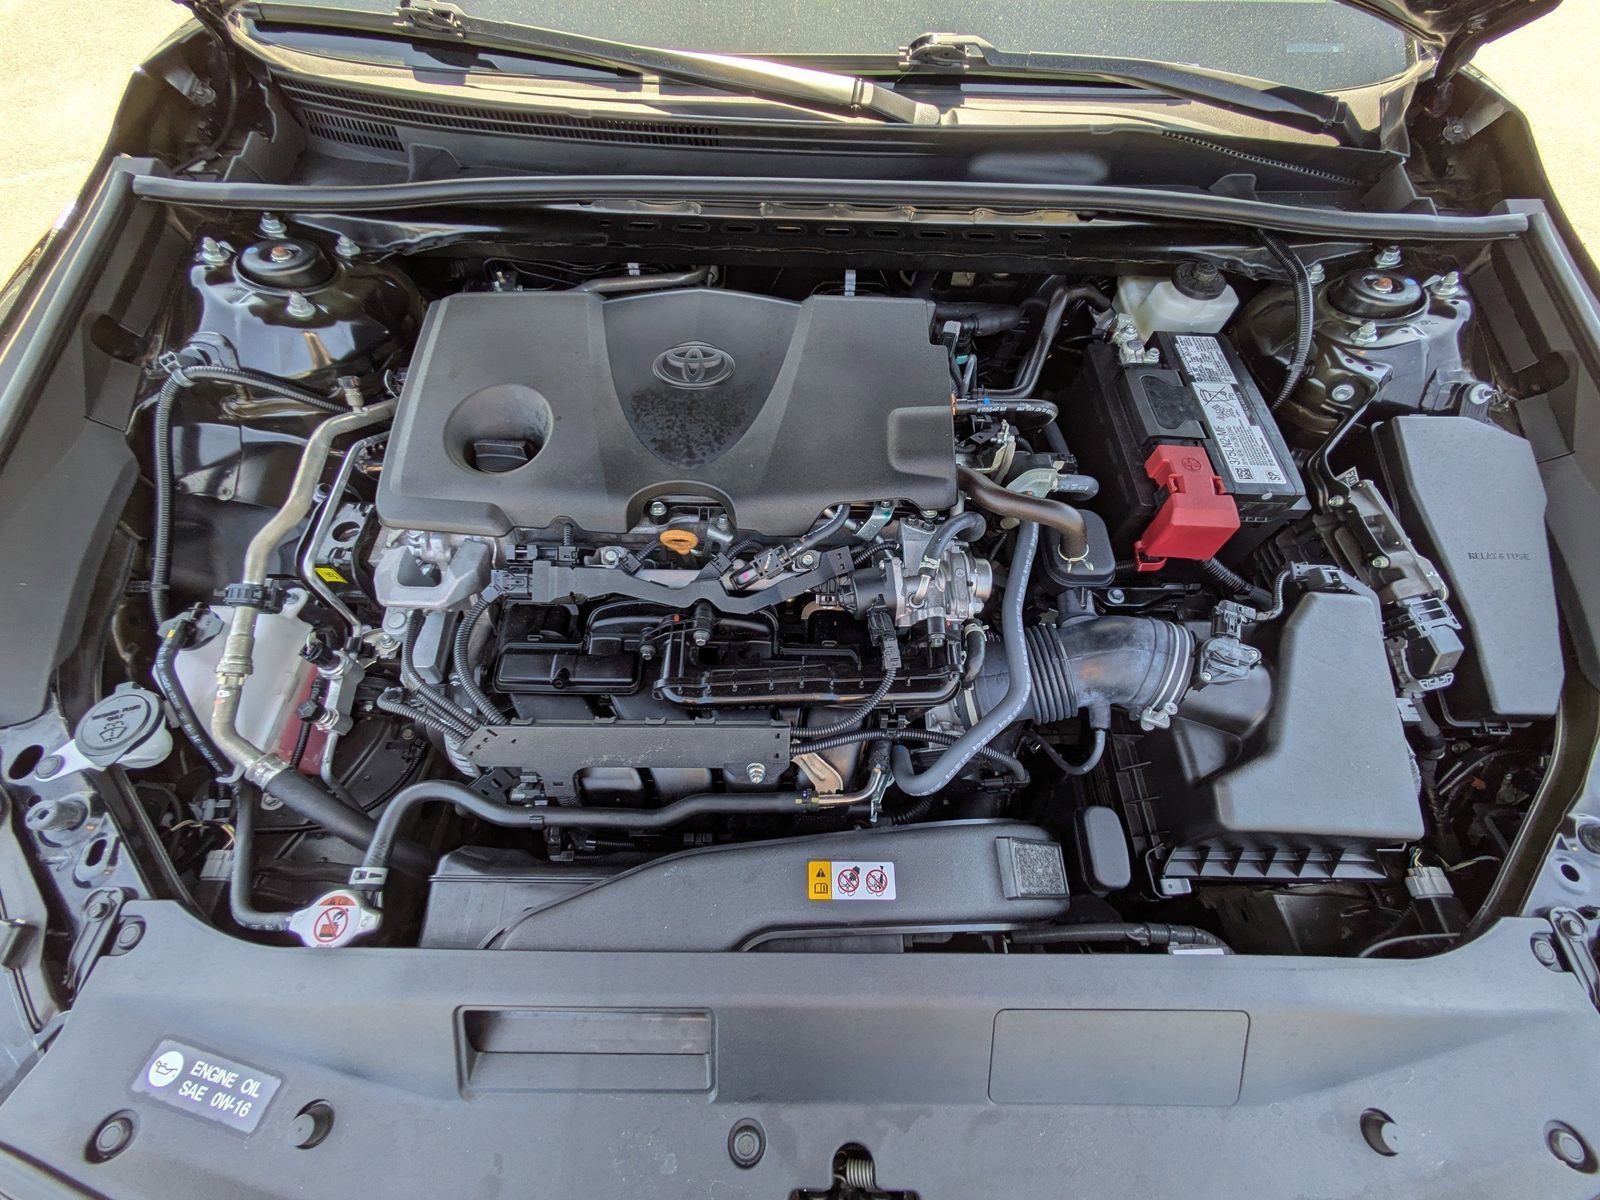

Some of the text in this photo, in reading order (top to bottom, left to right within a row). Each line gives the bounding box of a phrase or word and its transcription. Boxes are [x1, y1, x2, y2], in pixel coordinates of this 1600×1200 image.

[1267, 471, 1281, 481] SP
[190, 1060, 262, 1098] ENGINE OIL
[178, 1080, 252, 1118] SAE 0W-16
